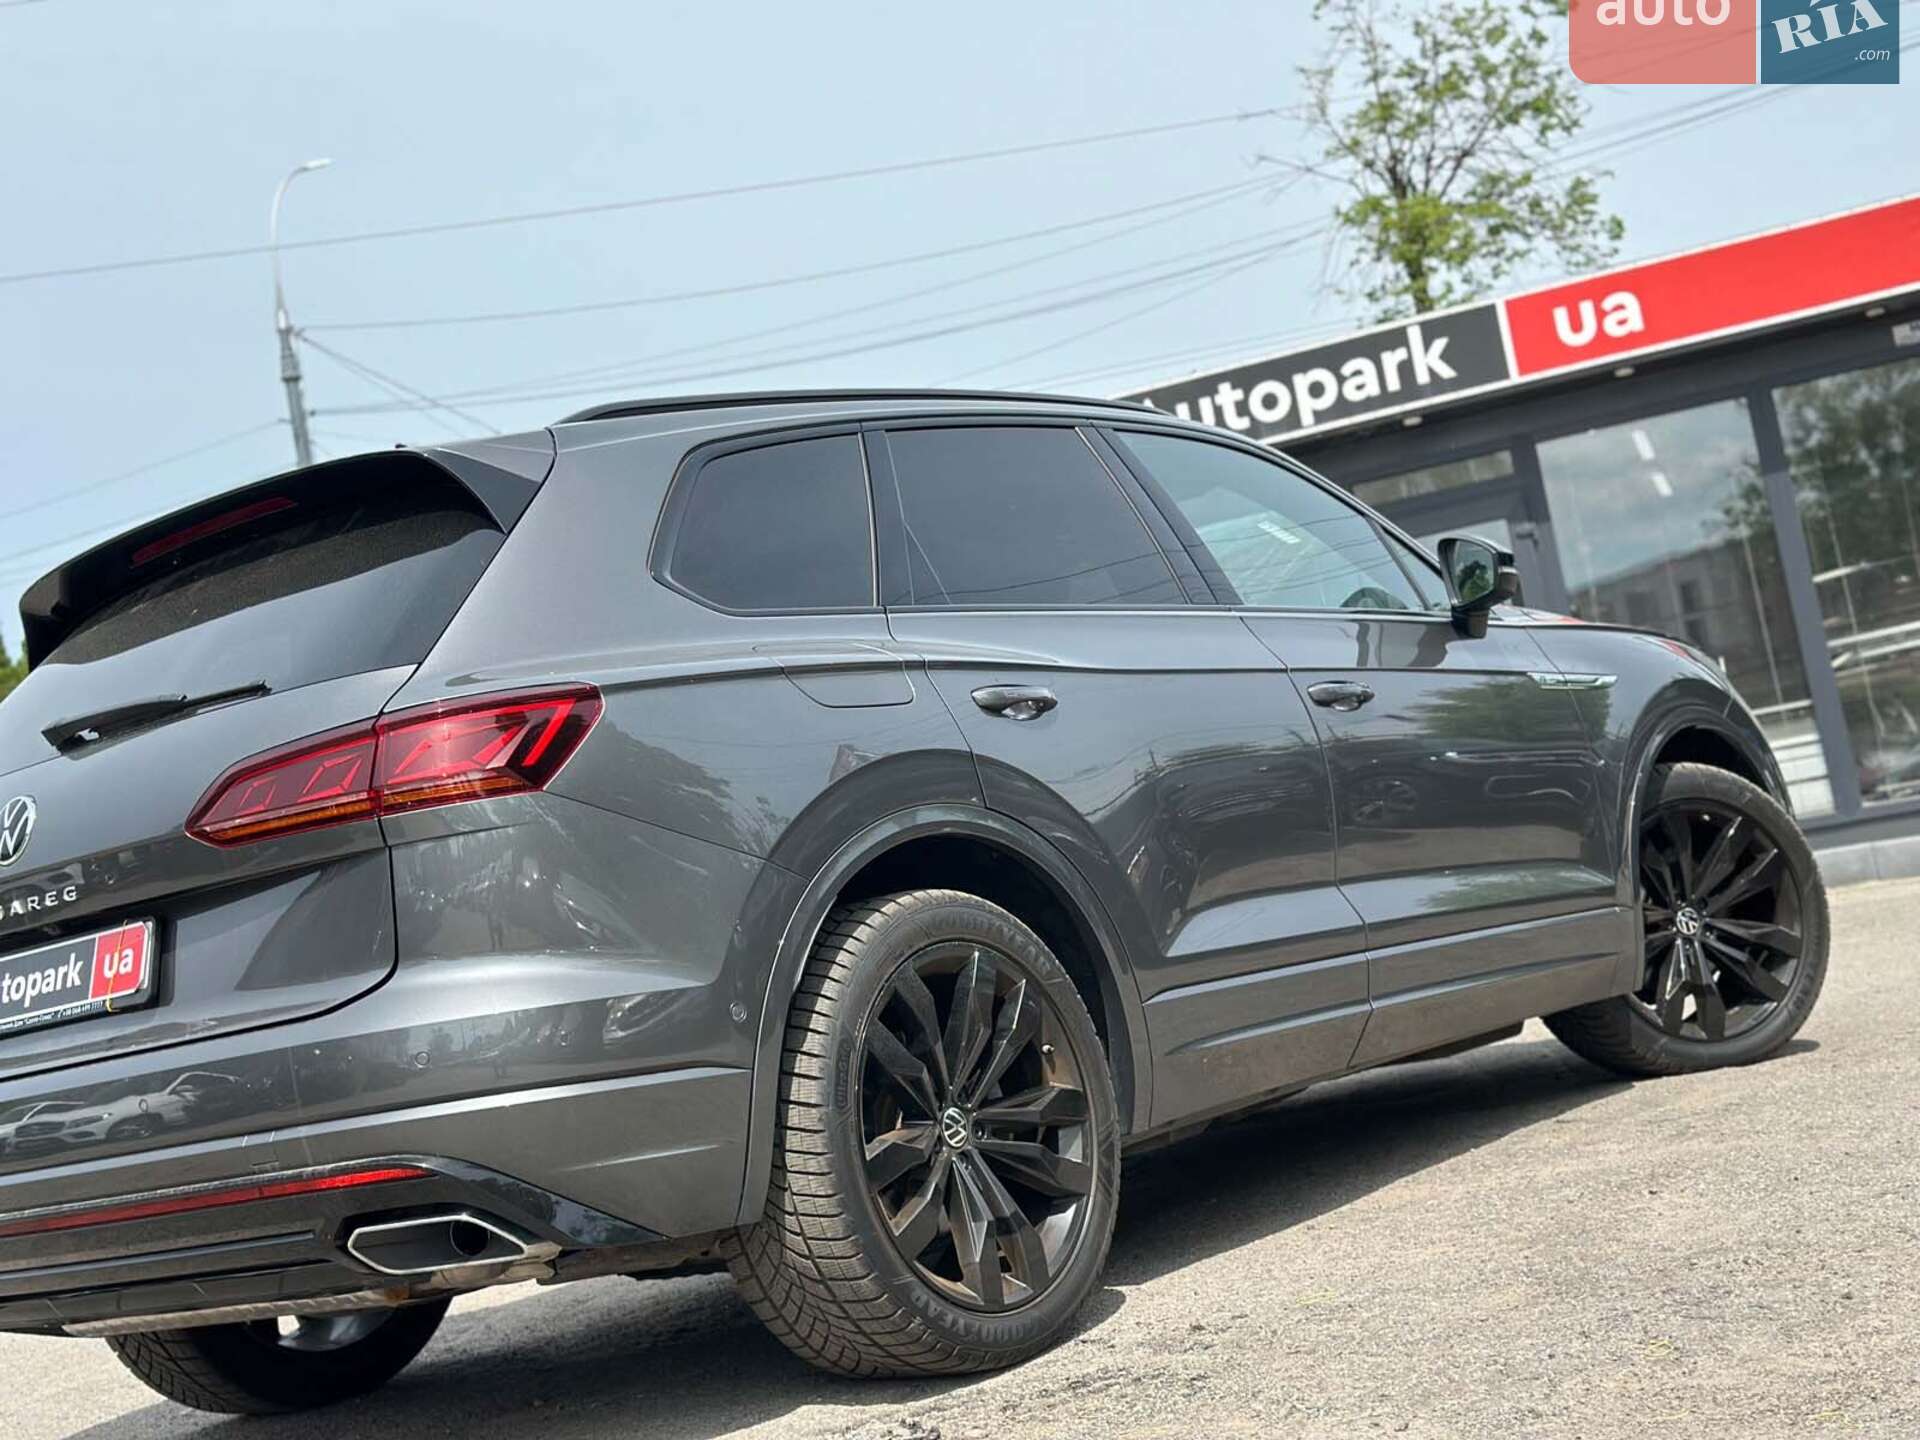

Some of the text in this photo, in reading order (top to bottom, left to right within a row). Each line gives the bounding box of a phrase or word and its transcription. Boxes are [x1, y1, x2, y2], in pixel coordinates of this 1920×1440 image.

[1143, 291, 1646, 431] utopark ua
[103, 948, 134, 979] ua
